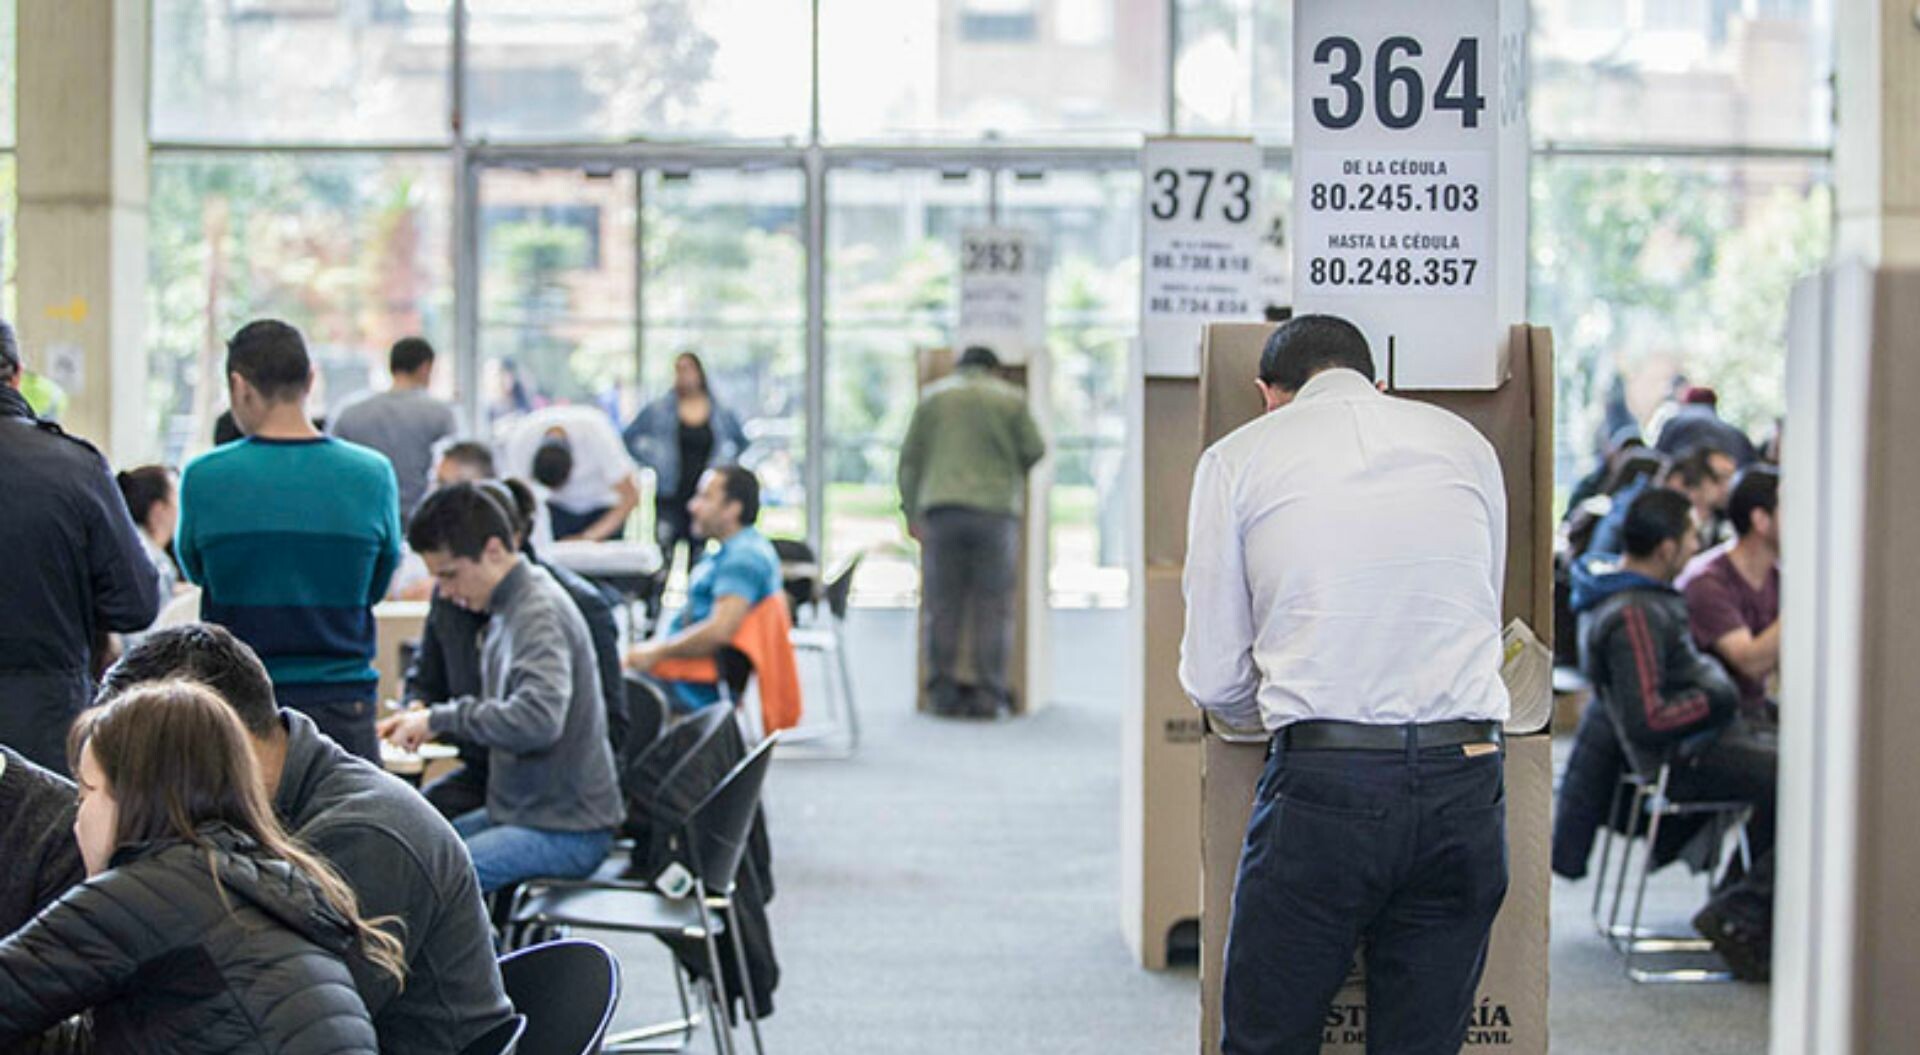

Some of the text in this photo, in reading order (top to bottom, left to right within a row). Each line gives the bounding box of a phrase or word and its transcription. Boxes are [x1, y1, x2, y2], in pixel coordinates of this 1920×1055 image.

[1311, 36, 1486, 129] 364
[1343, 157, 1448, 175] DE LA CÉDULA
[1151, 167, 1251, 223] 373
[1310, 183, 1480, 212] 80.245.103
[1328, 231, 1460, 250] HASTA LA CÉDULA
[1310, 257, 1479, 286] 80.248.357
[1466, 1031, 1512, 1044] CIVIL
